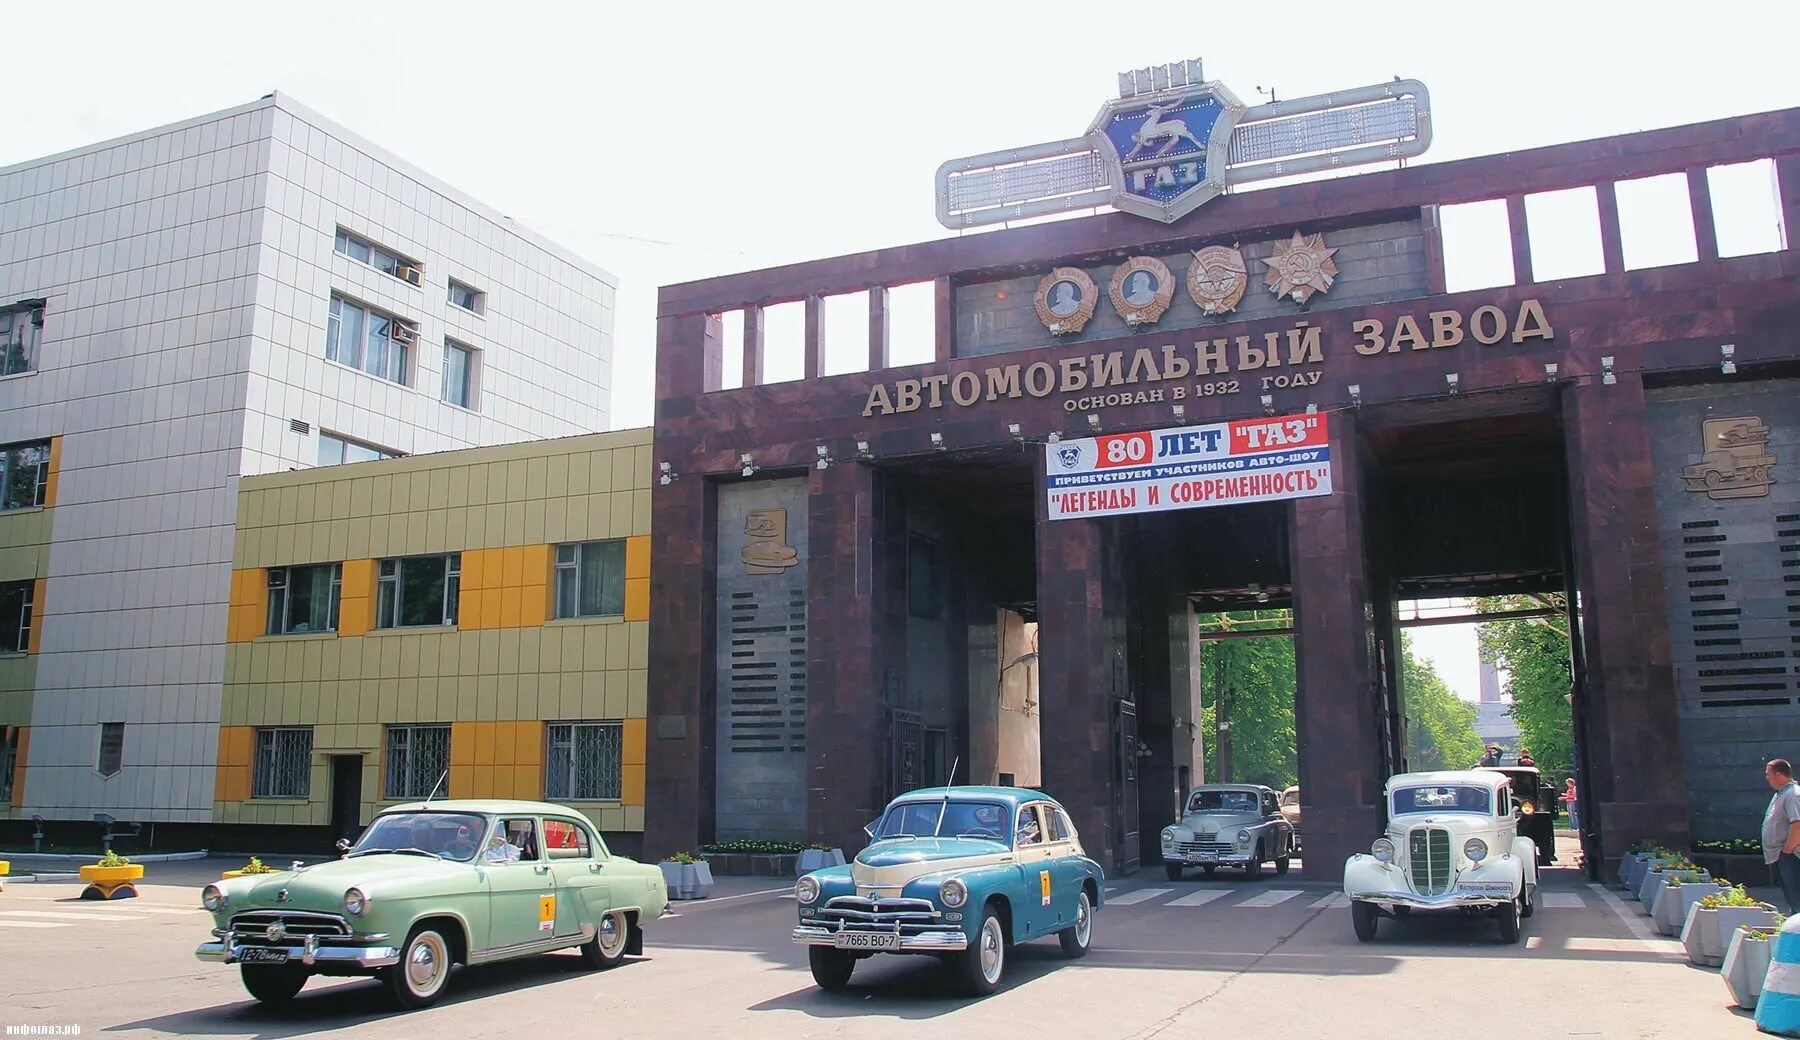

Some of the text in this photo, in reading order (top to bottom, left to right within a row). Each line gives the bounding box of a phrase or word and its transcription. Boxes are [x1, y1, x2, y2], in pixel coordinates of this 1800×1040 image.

[1133, 162, 1198, 192] ГАЗ
[862, 299, 1554, 417] АВТОМОБИЛЬНЫЙ ЗАВОД
[1063, 371, 1322, 412] ОСНОВАН В 1932 ГОДУ
[1106, 417, 1318, 463] 80 ЛЕТ "ГАЗ"
[1055, 450, 1319, 486] ПРИВЕТСТВУЕМ УЧАСТНИКОВ АВТО-ШОУ
[1051, 468, 1327, 513] "ЛЕГЕНДЫ И СОВРЕМЕННОСТЬ"
[545, 902, 549, 916] 1
[846, 934, 868, 946] 7665
[871, 935, 895, 947] BO-7
